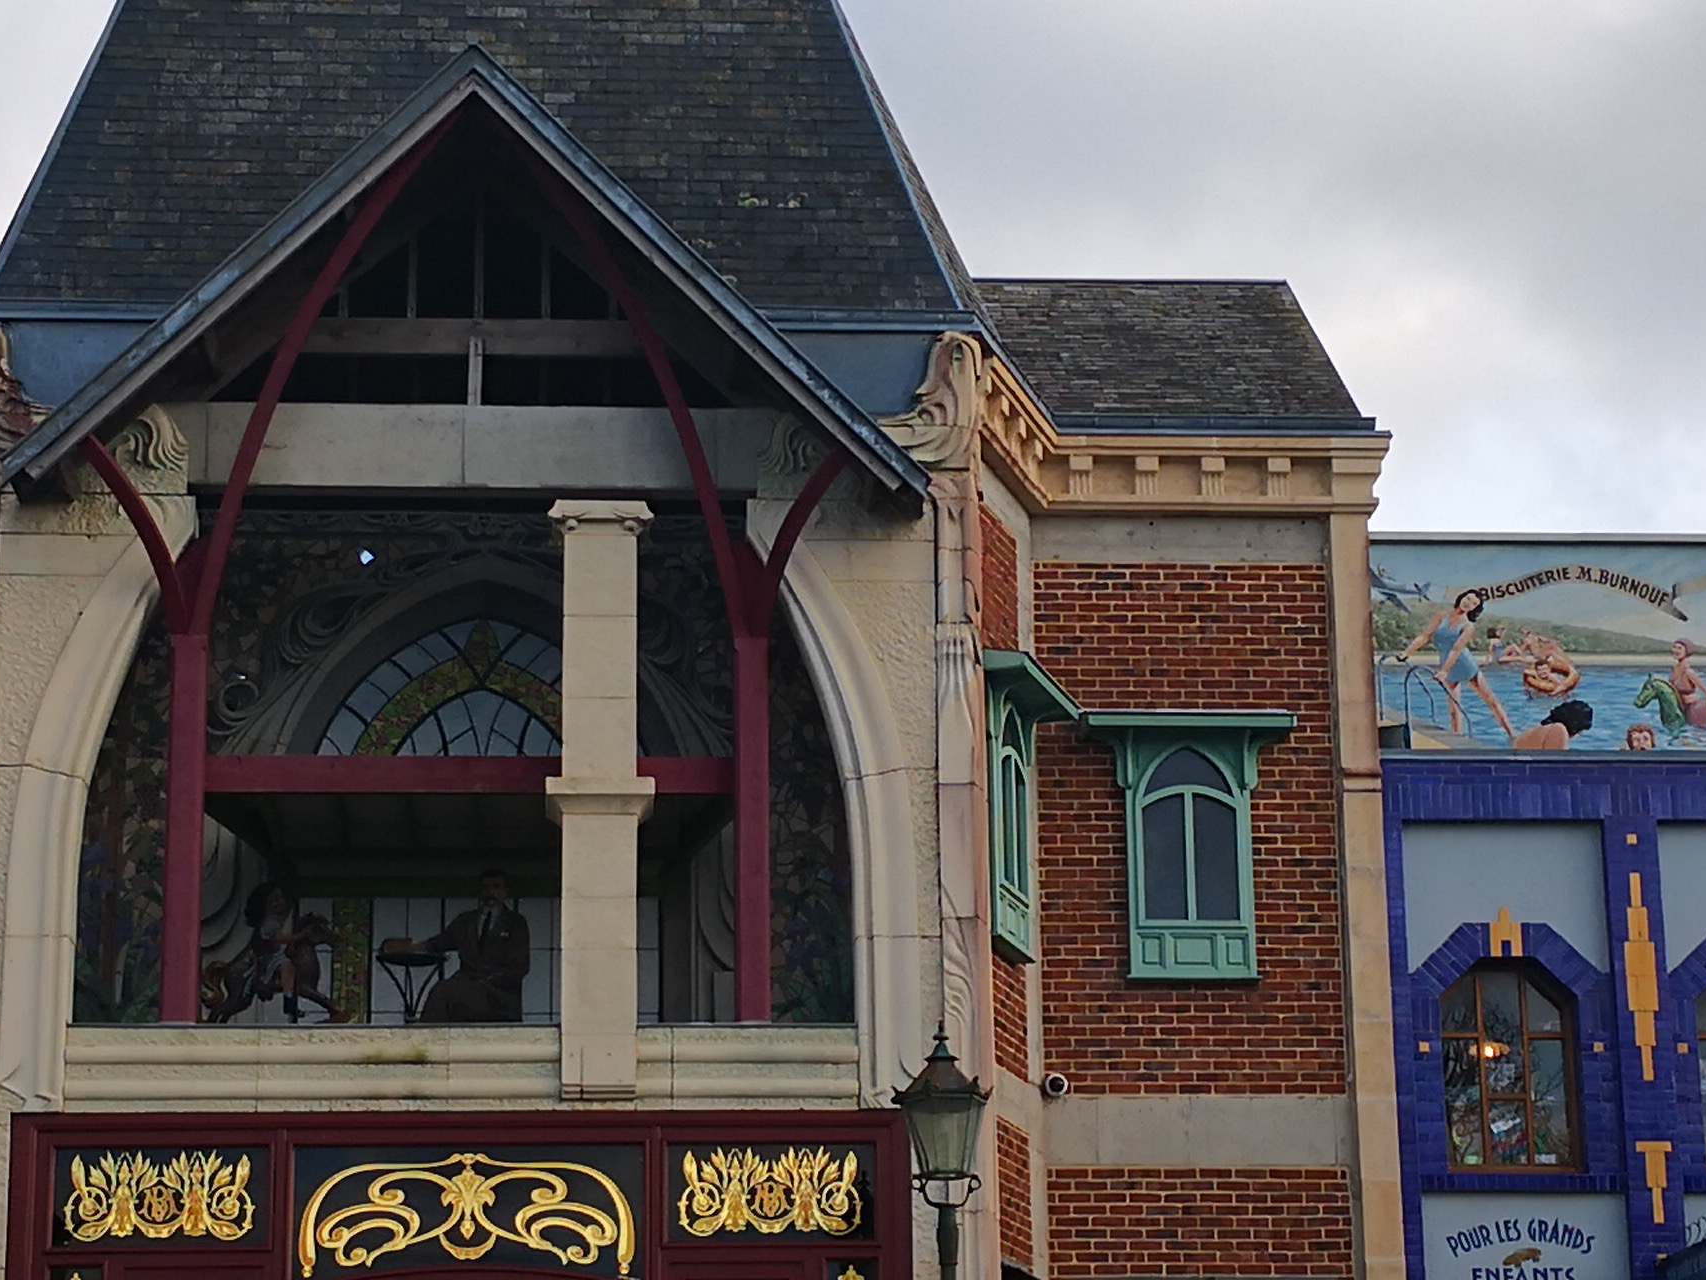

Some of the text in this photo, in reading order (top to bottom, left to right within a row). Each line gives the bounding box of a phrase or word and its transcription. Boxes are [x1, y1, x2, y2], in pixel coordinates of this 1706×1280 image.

[1482, 566, 1572, 602] BISCUITERIE
[1446, 1217, 1596, 1258] POUR LES GRANDS
